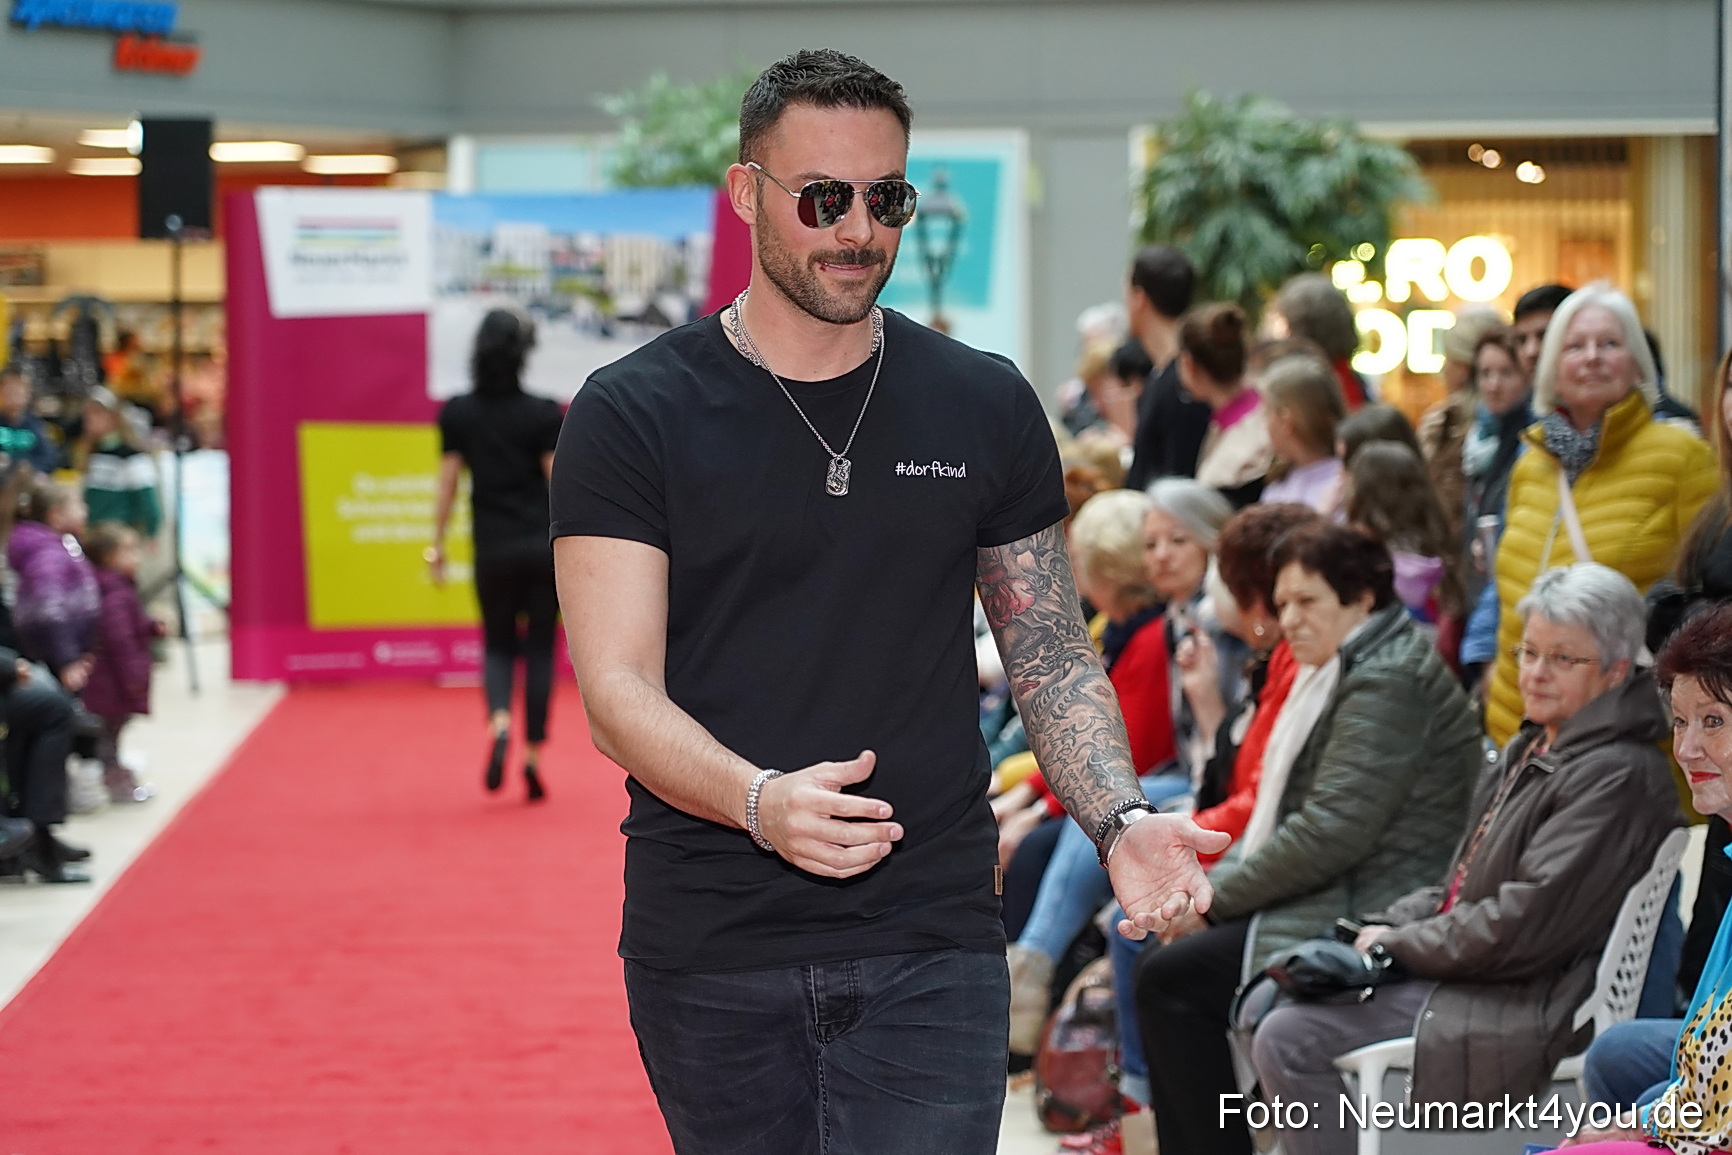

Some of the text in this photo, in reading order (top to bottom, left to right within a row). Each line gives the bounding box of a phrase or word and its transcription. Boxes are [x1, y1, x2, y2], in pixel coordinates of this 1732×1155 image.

[894, 459, 967, 479] #dorfkind
[1046, 742, 1079, 770] God
[1067, 768, 1080, 785] can
